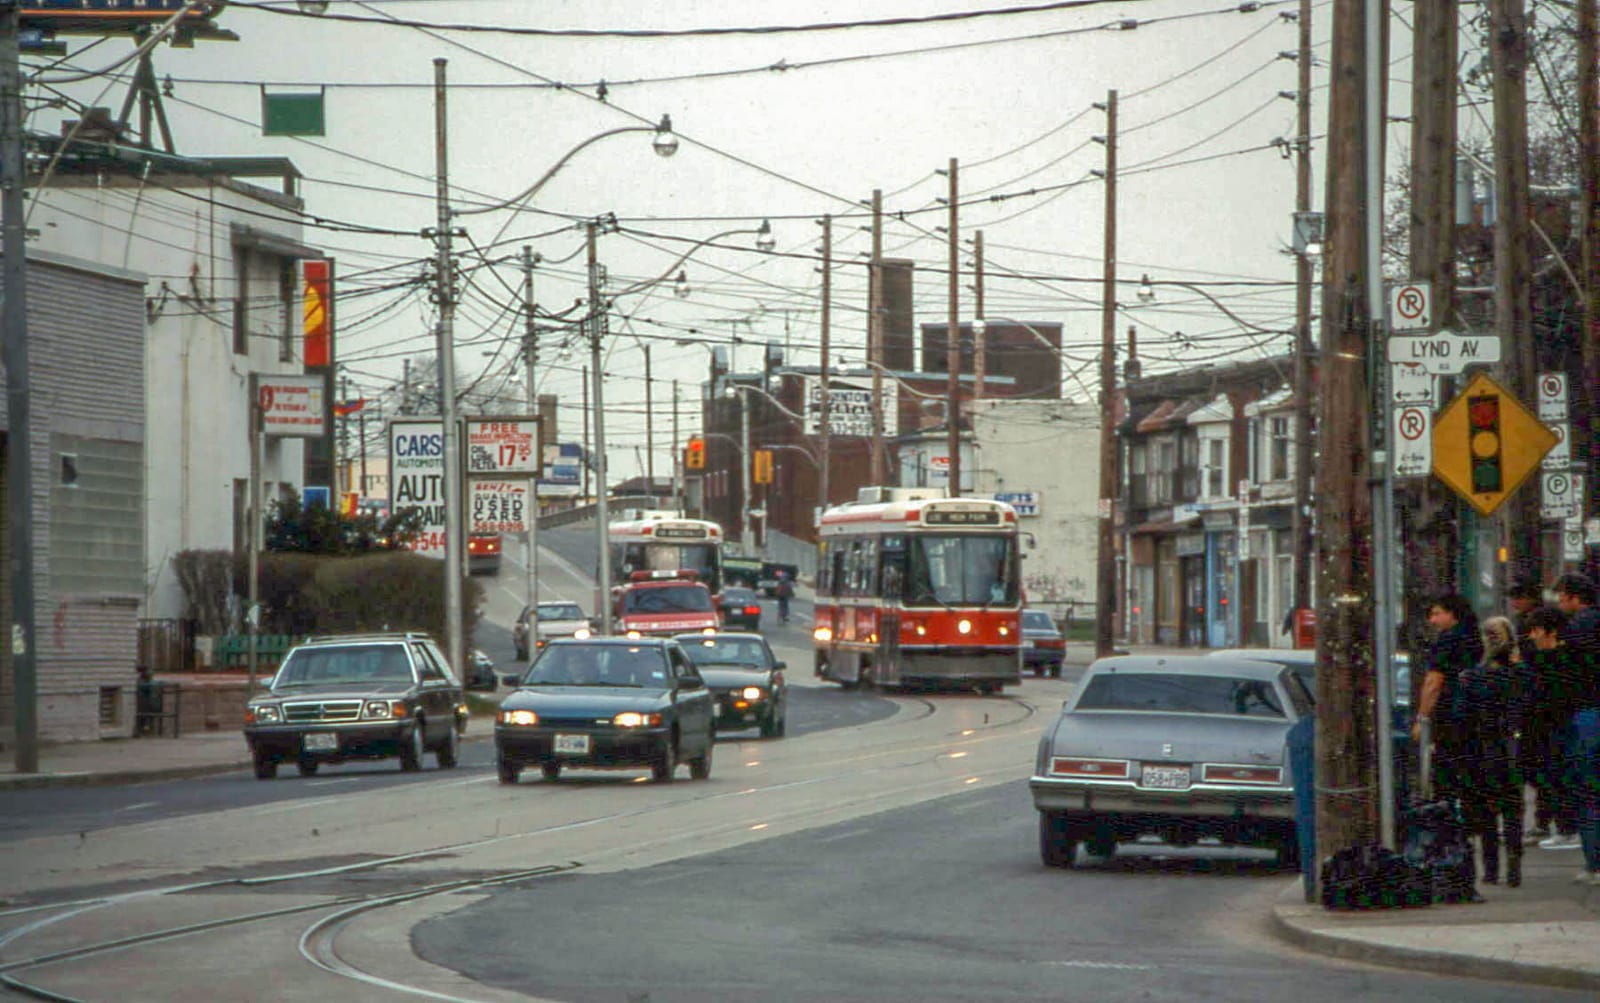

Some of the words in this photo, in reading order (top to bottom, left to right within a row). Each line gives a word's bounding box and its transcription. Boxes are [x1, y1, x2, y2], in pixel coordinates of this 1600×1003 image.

[1411, 340, 1451, 358] LYND
[480, 422, 519, 433] FREE
[499, 445, 516, 466] 17
[474, 500, 523, 511] USED
[473, 511, 522, 521] CARS
